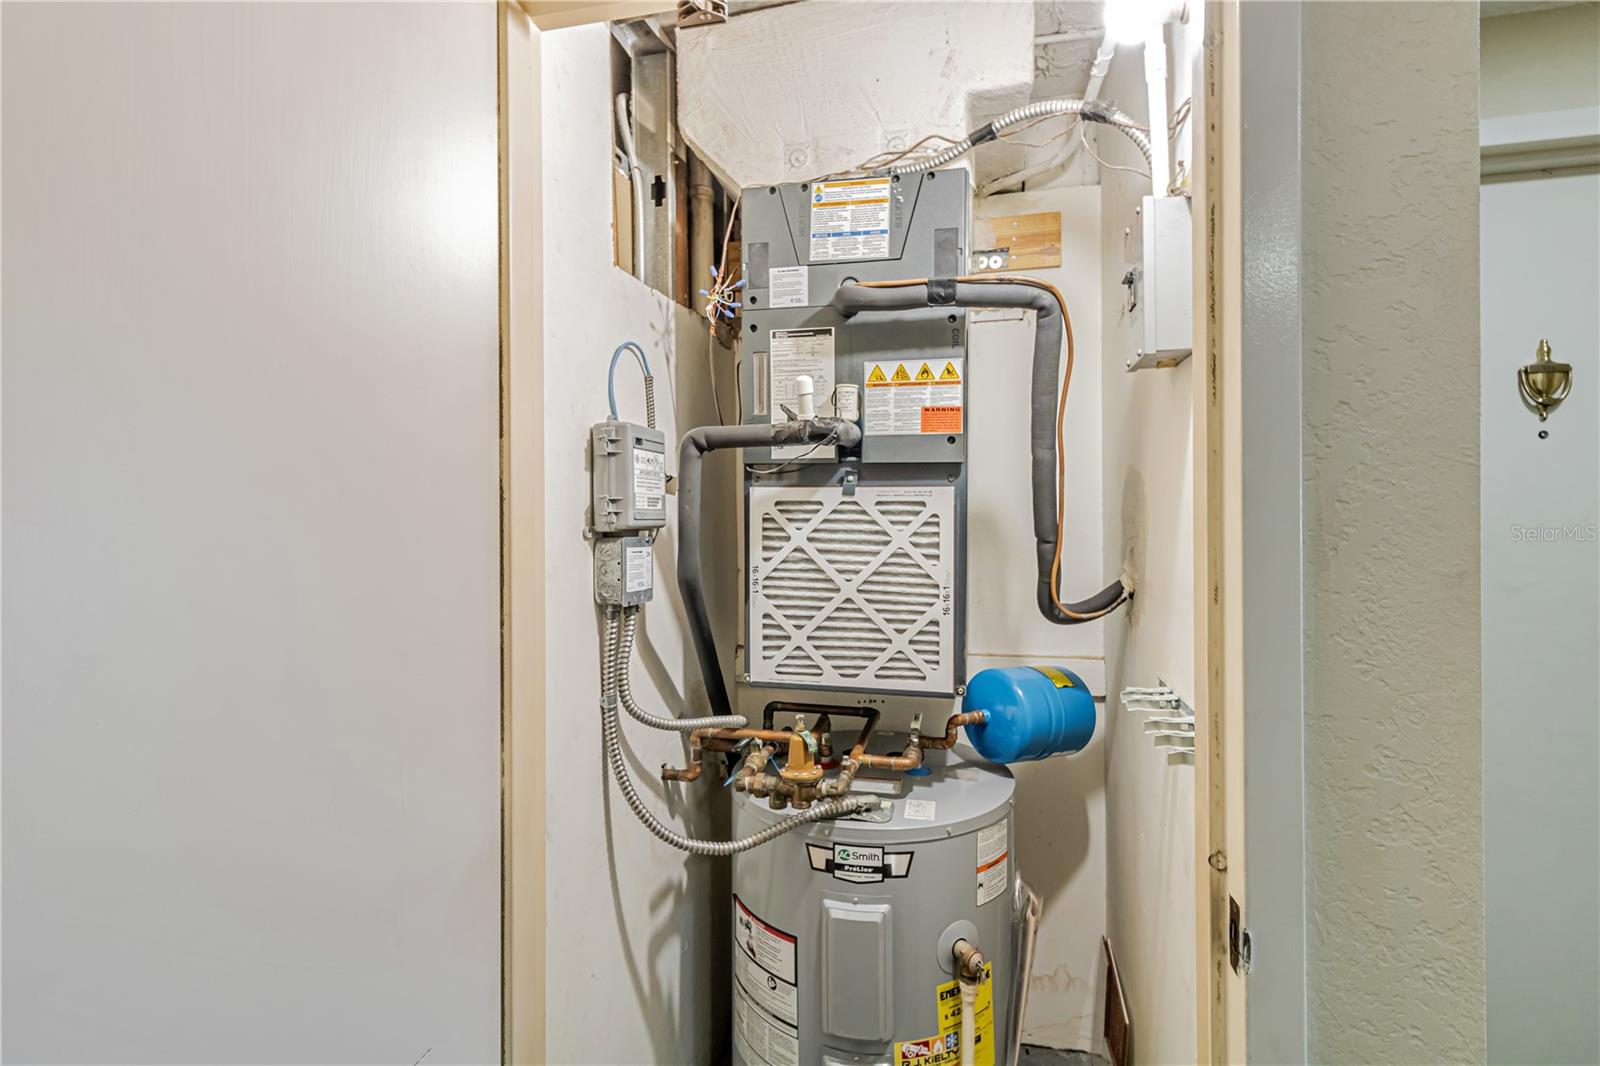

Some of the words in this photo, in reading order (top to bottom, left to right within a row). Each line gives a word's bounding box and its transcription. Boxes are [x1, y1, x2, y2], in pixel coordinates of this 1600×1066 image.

[951, 328, 960, 349] COIL
[851, 851, 880, 862] Smith
[924, 1048, 960, 1064] KIELTY
